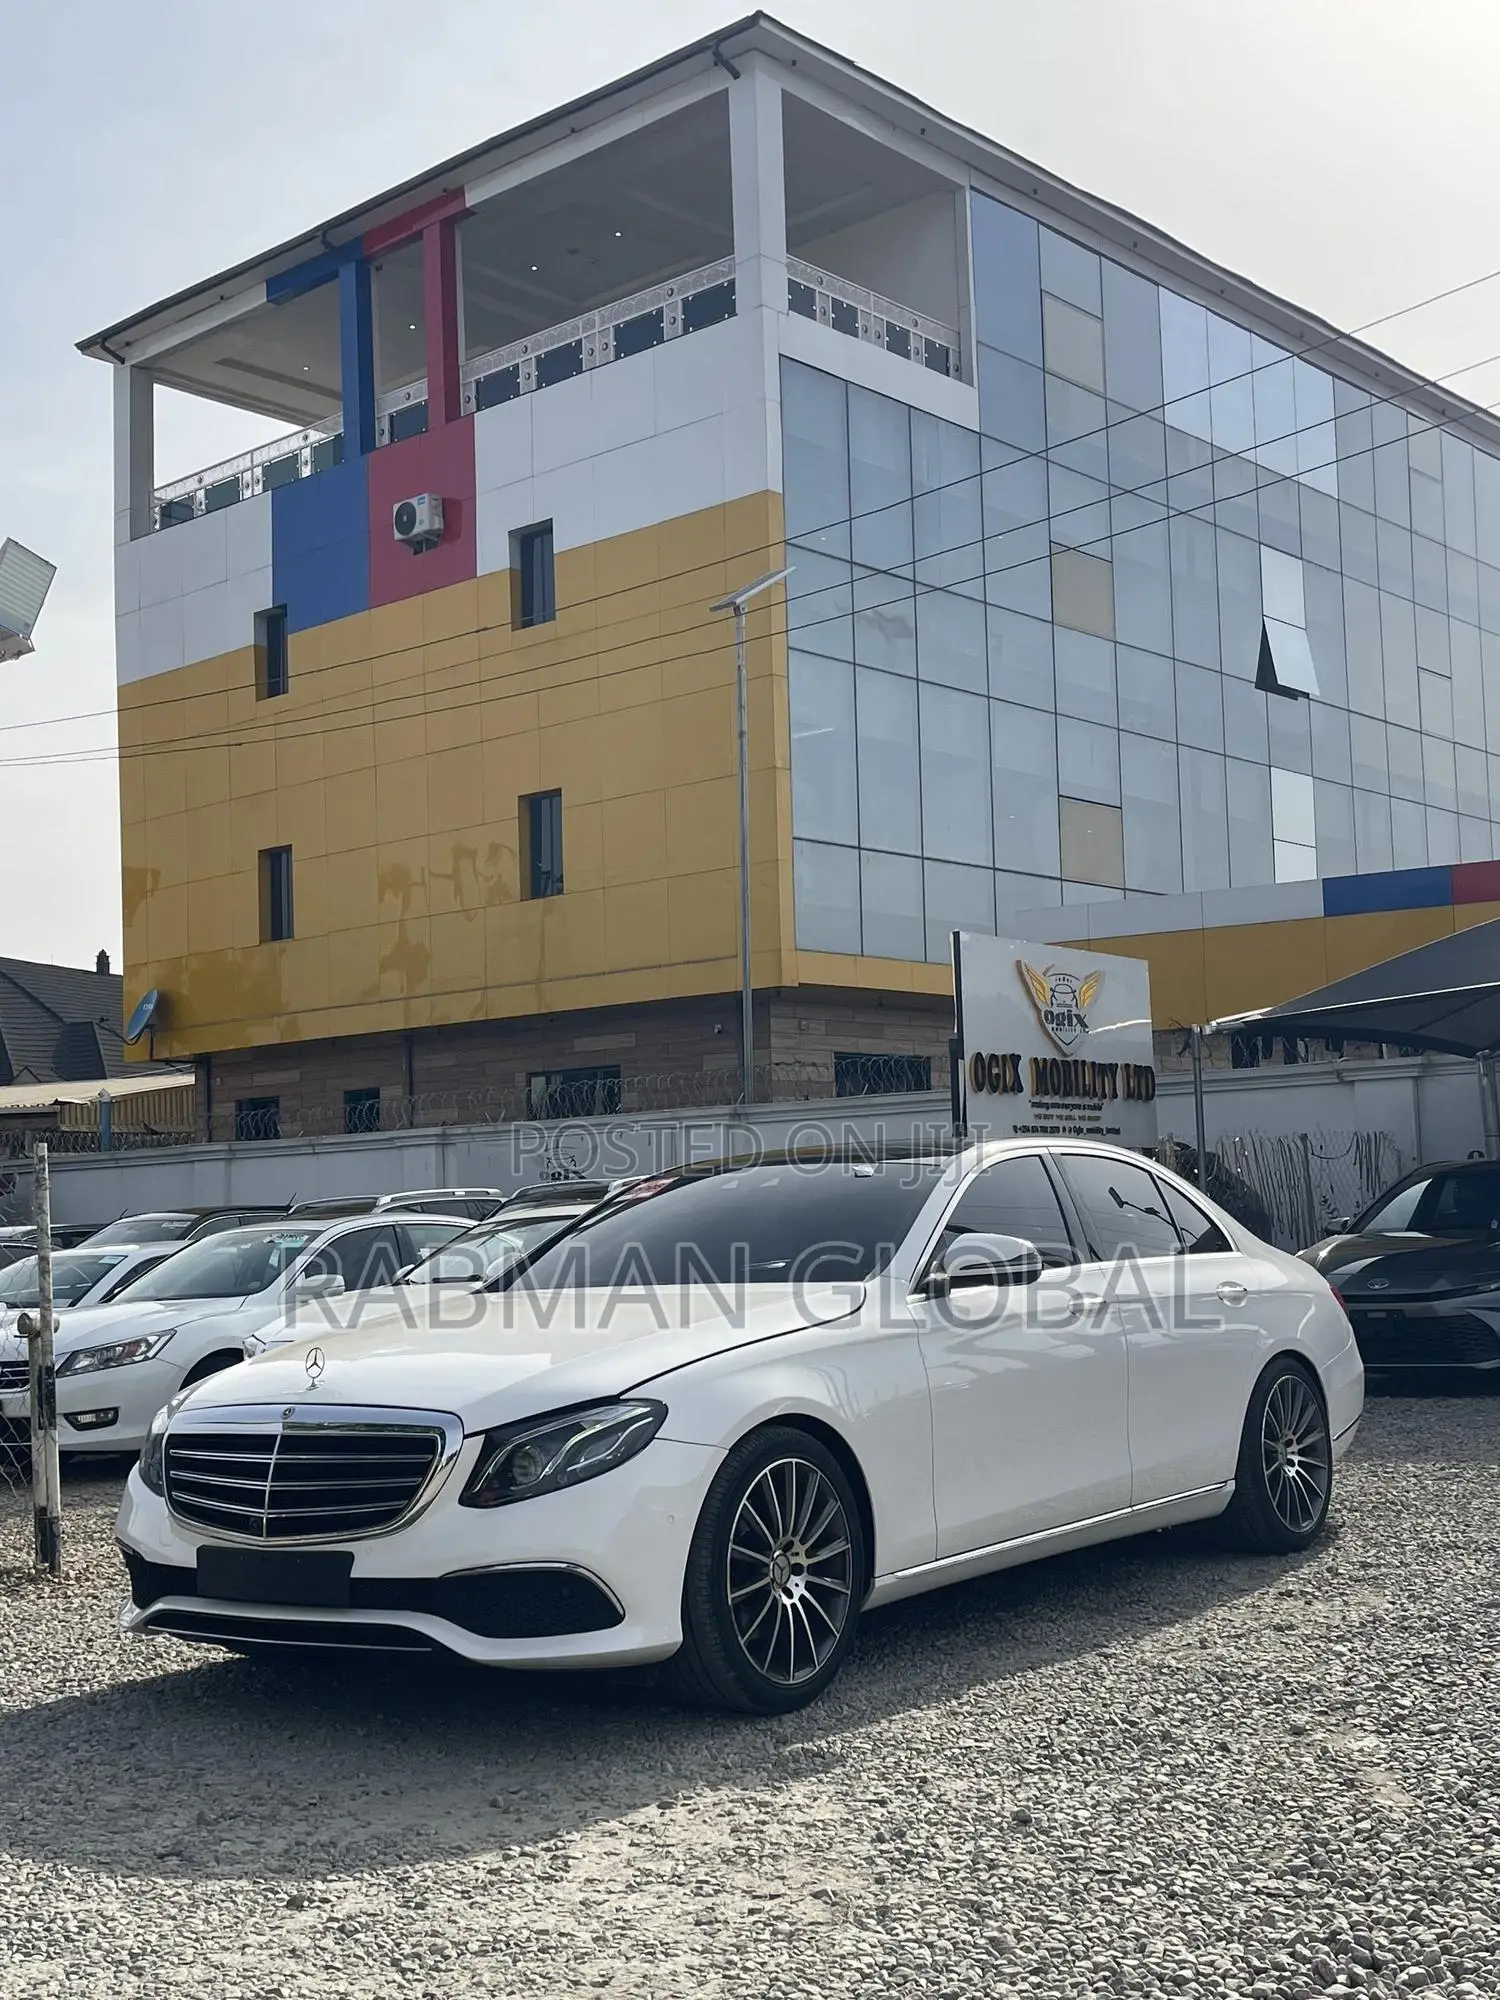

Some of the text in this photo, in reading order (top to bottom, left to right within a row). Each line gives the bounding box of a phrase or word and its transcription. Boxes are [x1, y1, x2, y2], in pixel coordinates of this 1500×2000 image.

[970, 1051, 1156, 1101] OGIX MOBILITY LTD
